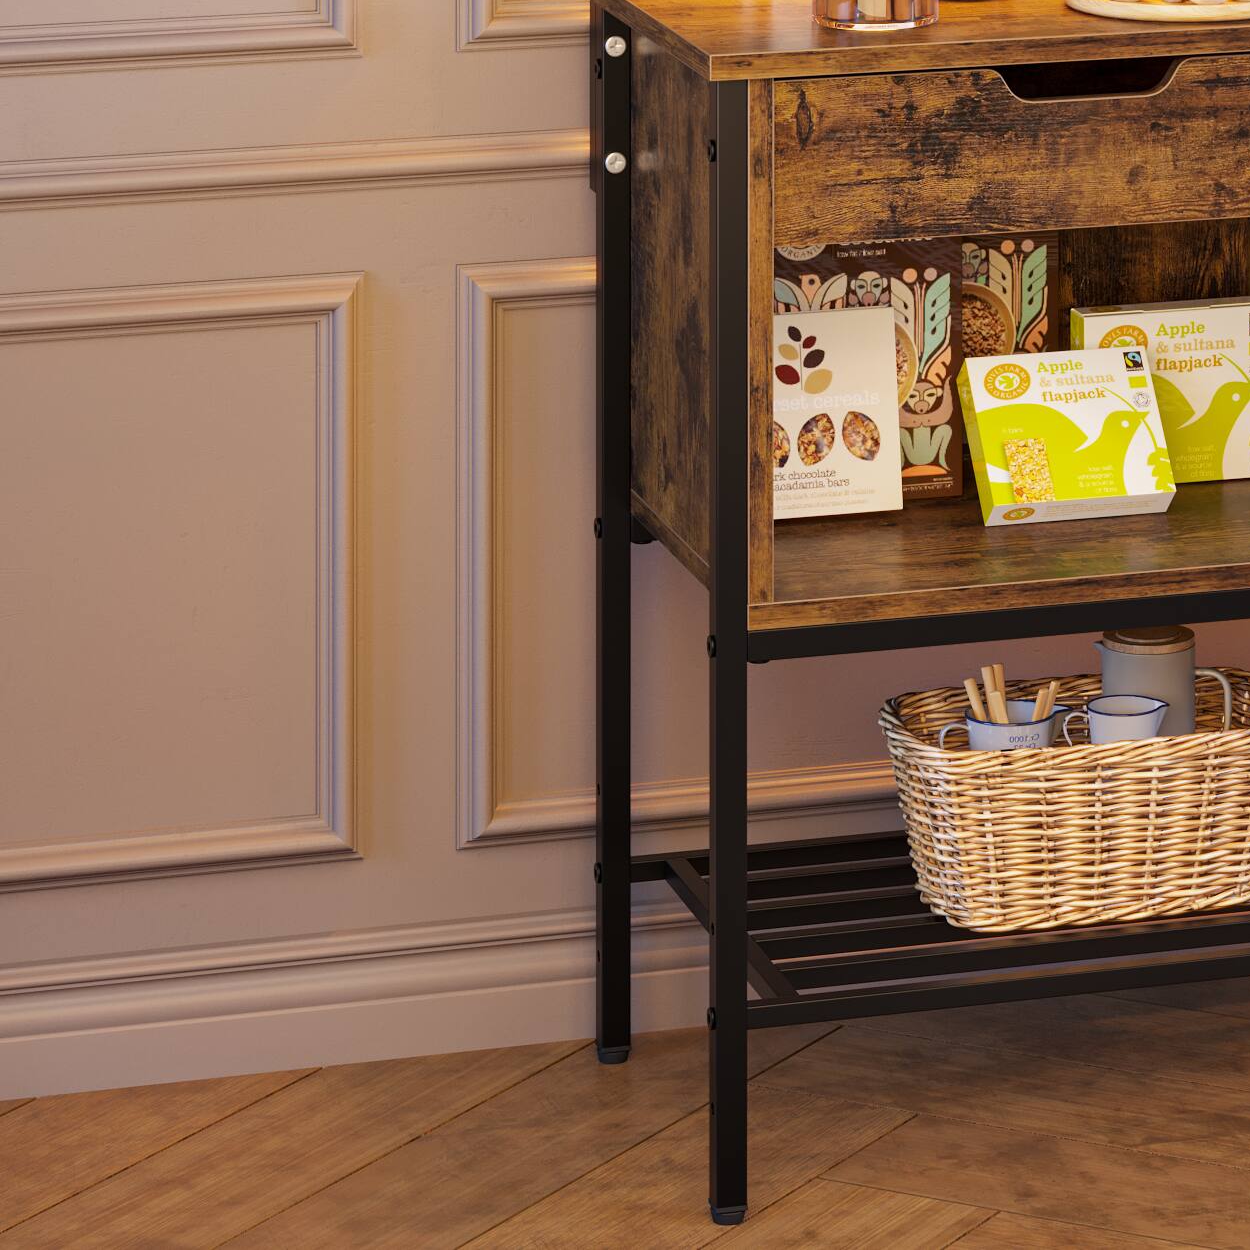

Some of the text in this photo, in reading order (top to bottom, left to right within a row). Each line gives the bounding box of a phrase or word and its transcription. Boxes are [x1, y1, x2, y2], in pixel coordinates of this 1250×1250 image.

[1155, 321, 1205, 338] Apple
[1156, 338, 1236, 353] & sultana
[1037, 360, 1083, 374] Apple
[1155, 354, 1223, 372] flapjack
[1039, 374, 1116, 388] & sultana
[815, 389, 880, 410] cereals
[1041, 387, 1107, 403] flapjack
[788, 469, 836, 480] chocolate
[827, 478, 850, 487] bars
